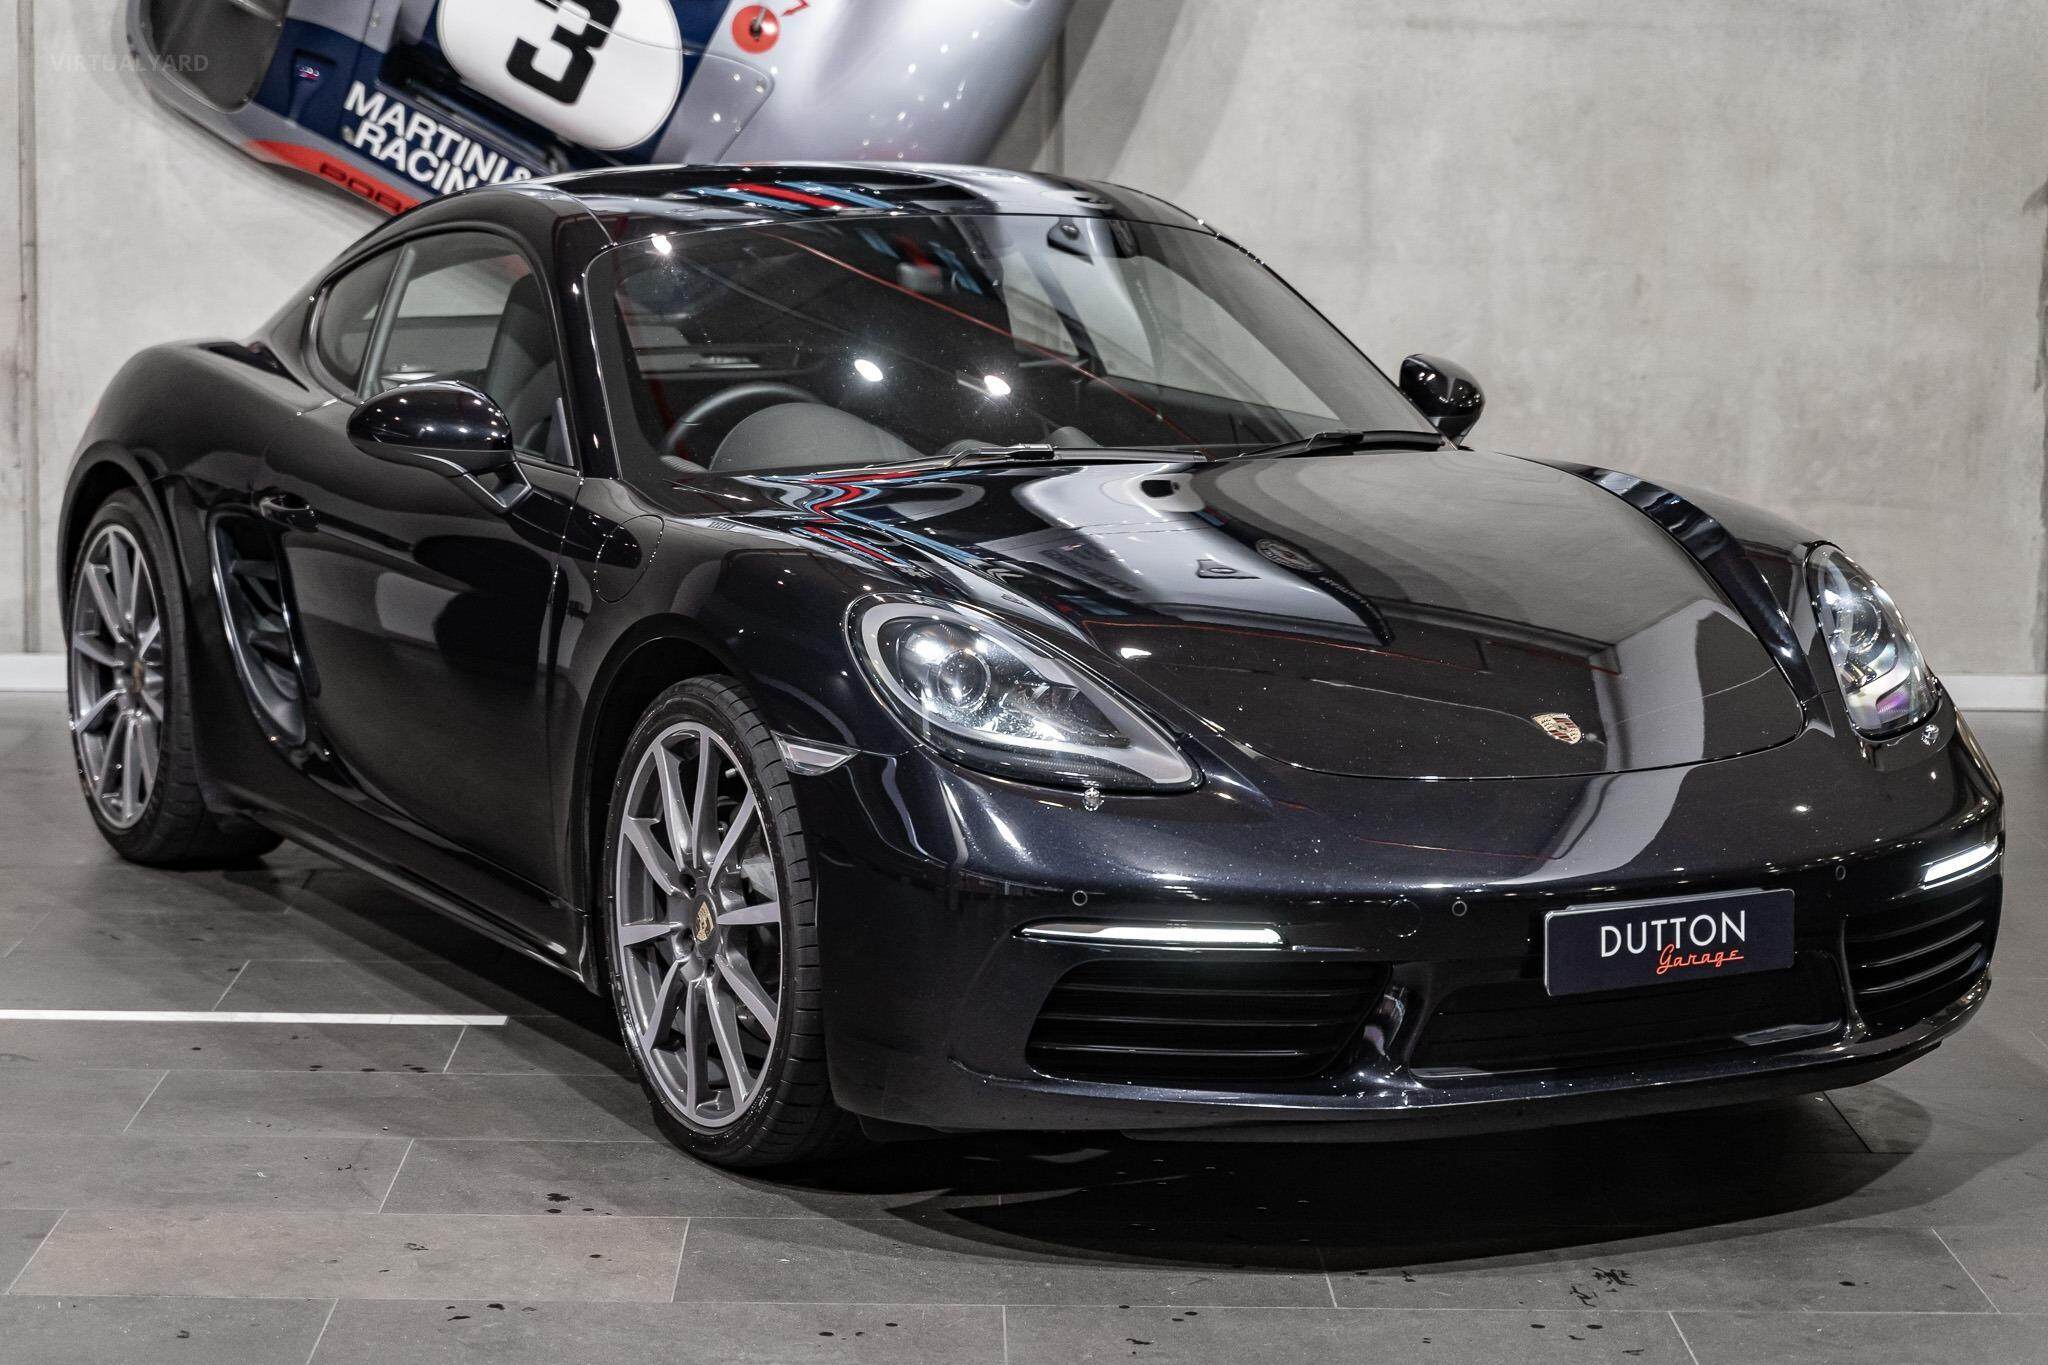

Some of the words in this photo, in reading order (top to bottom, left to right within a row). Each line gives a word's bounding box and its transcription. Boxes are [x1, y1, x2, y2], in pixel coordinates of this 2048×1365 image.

[505, 0, 620, 106] 3
[344, 80, 509, 184] MARTINI
[354, 120, 479, 195] RACIN
[1601, 910, 1746, 958] DUTTON
[1656, 944, 1745, 975] Garage
